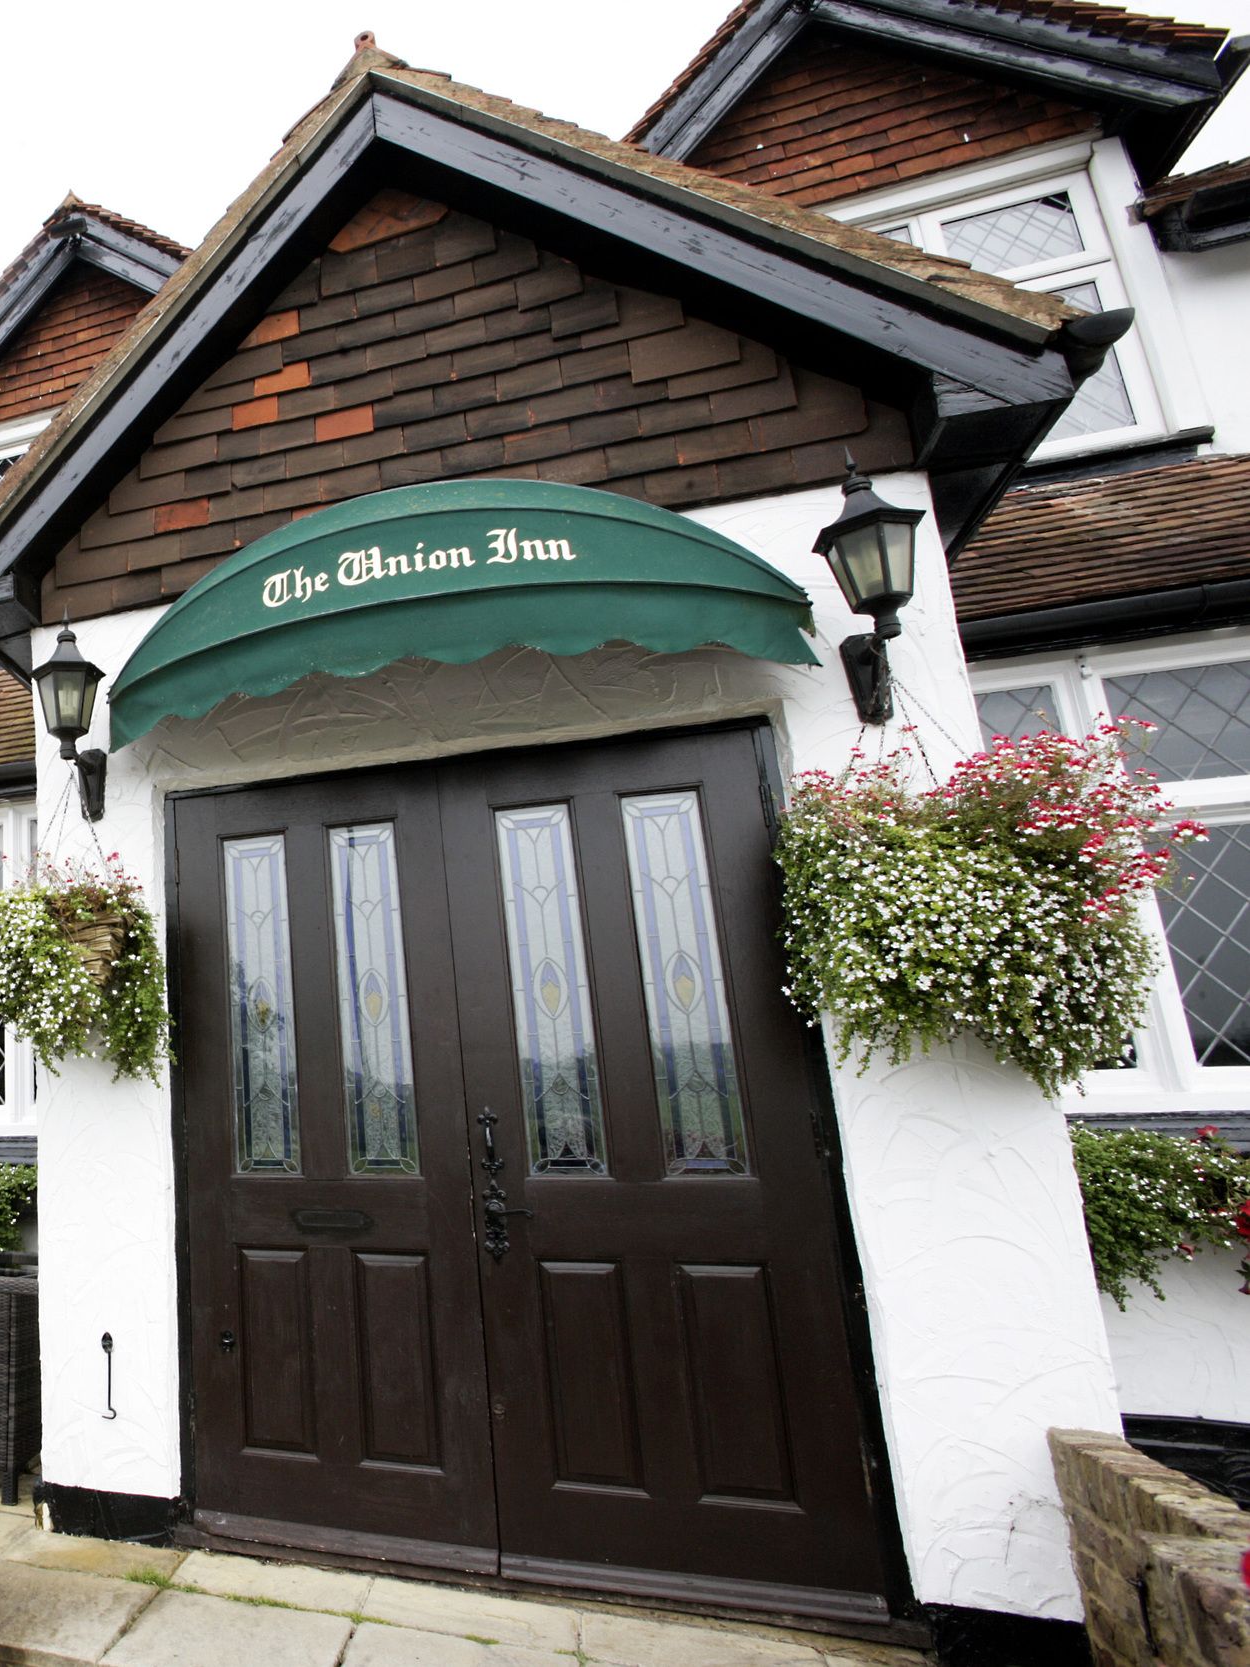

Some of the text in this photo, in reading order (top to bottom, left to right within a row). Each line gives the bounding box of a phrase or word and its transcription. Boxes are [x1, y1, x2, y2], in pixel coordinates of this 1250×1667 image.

[262, 527, 577, 608] The Union Inn
